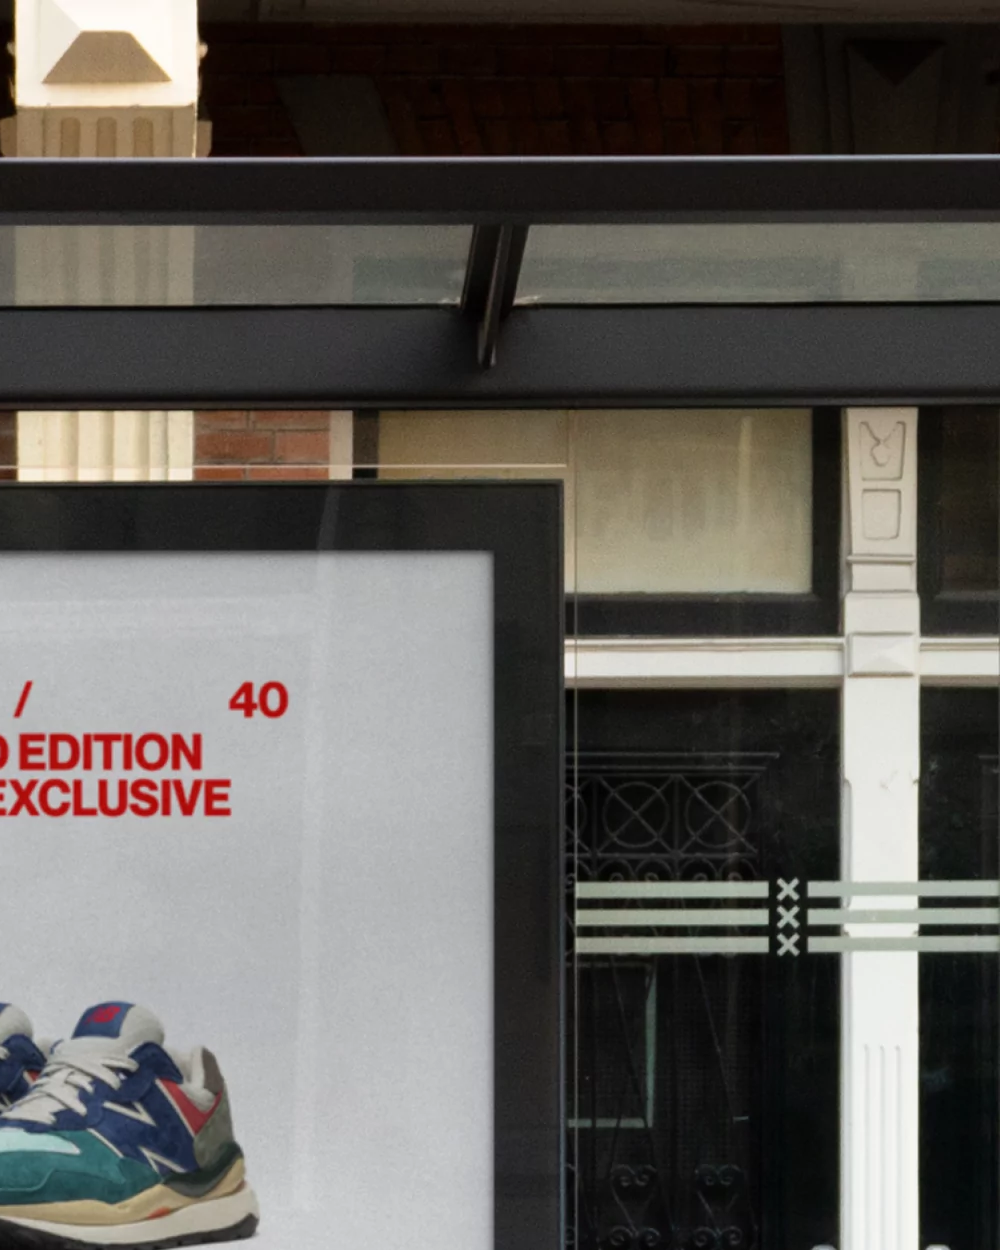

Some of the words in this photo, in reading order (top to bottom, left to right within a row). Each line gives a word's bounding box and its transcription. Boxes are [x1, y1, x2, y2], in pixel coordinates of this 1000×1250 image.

[13, 680, 33, 718] /
[228, 681, 289, 719] 40
[18, 732, 203, 772] EDITION
